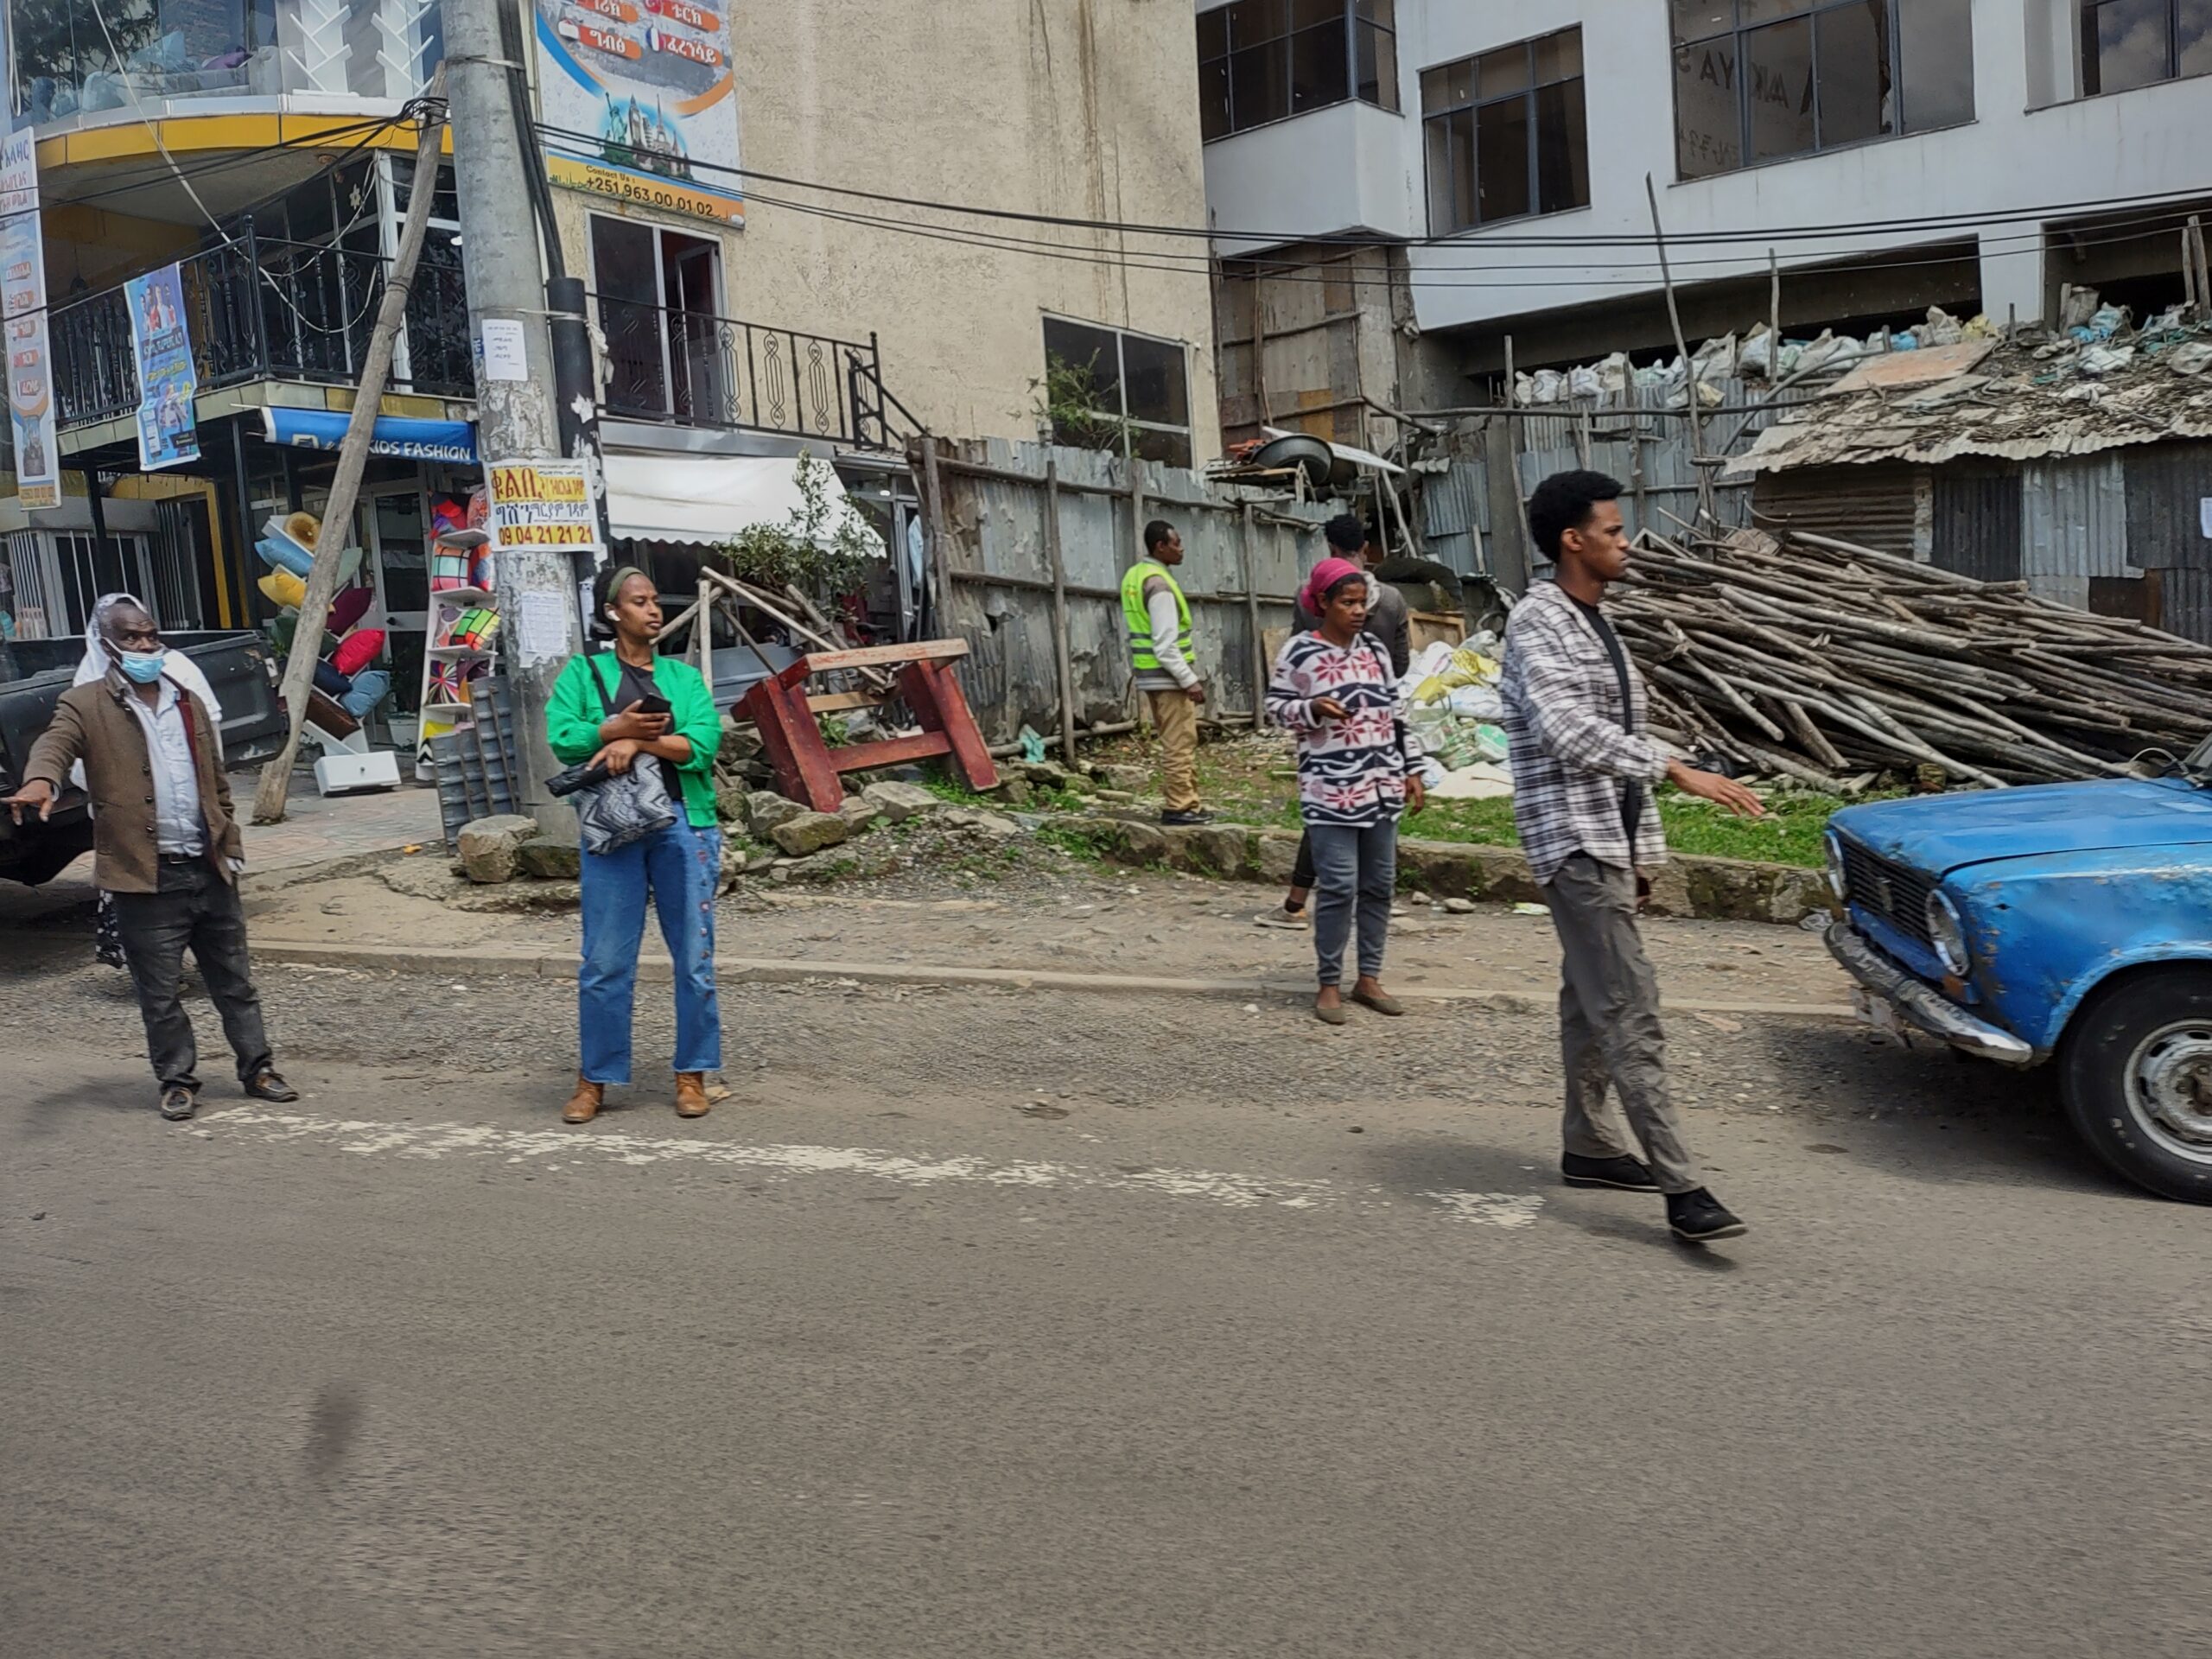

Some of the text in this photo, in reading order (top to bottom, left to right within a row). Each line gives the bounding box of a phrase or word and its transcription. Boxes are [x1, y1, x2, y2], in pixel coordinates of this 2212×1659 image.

[586, 165, 618, 180] Contact
[404, 442, 471, 461] FASHION
[499, 524, 594, 546] 09 04 21 21 21
